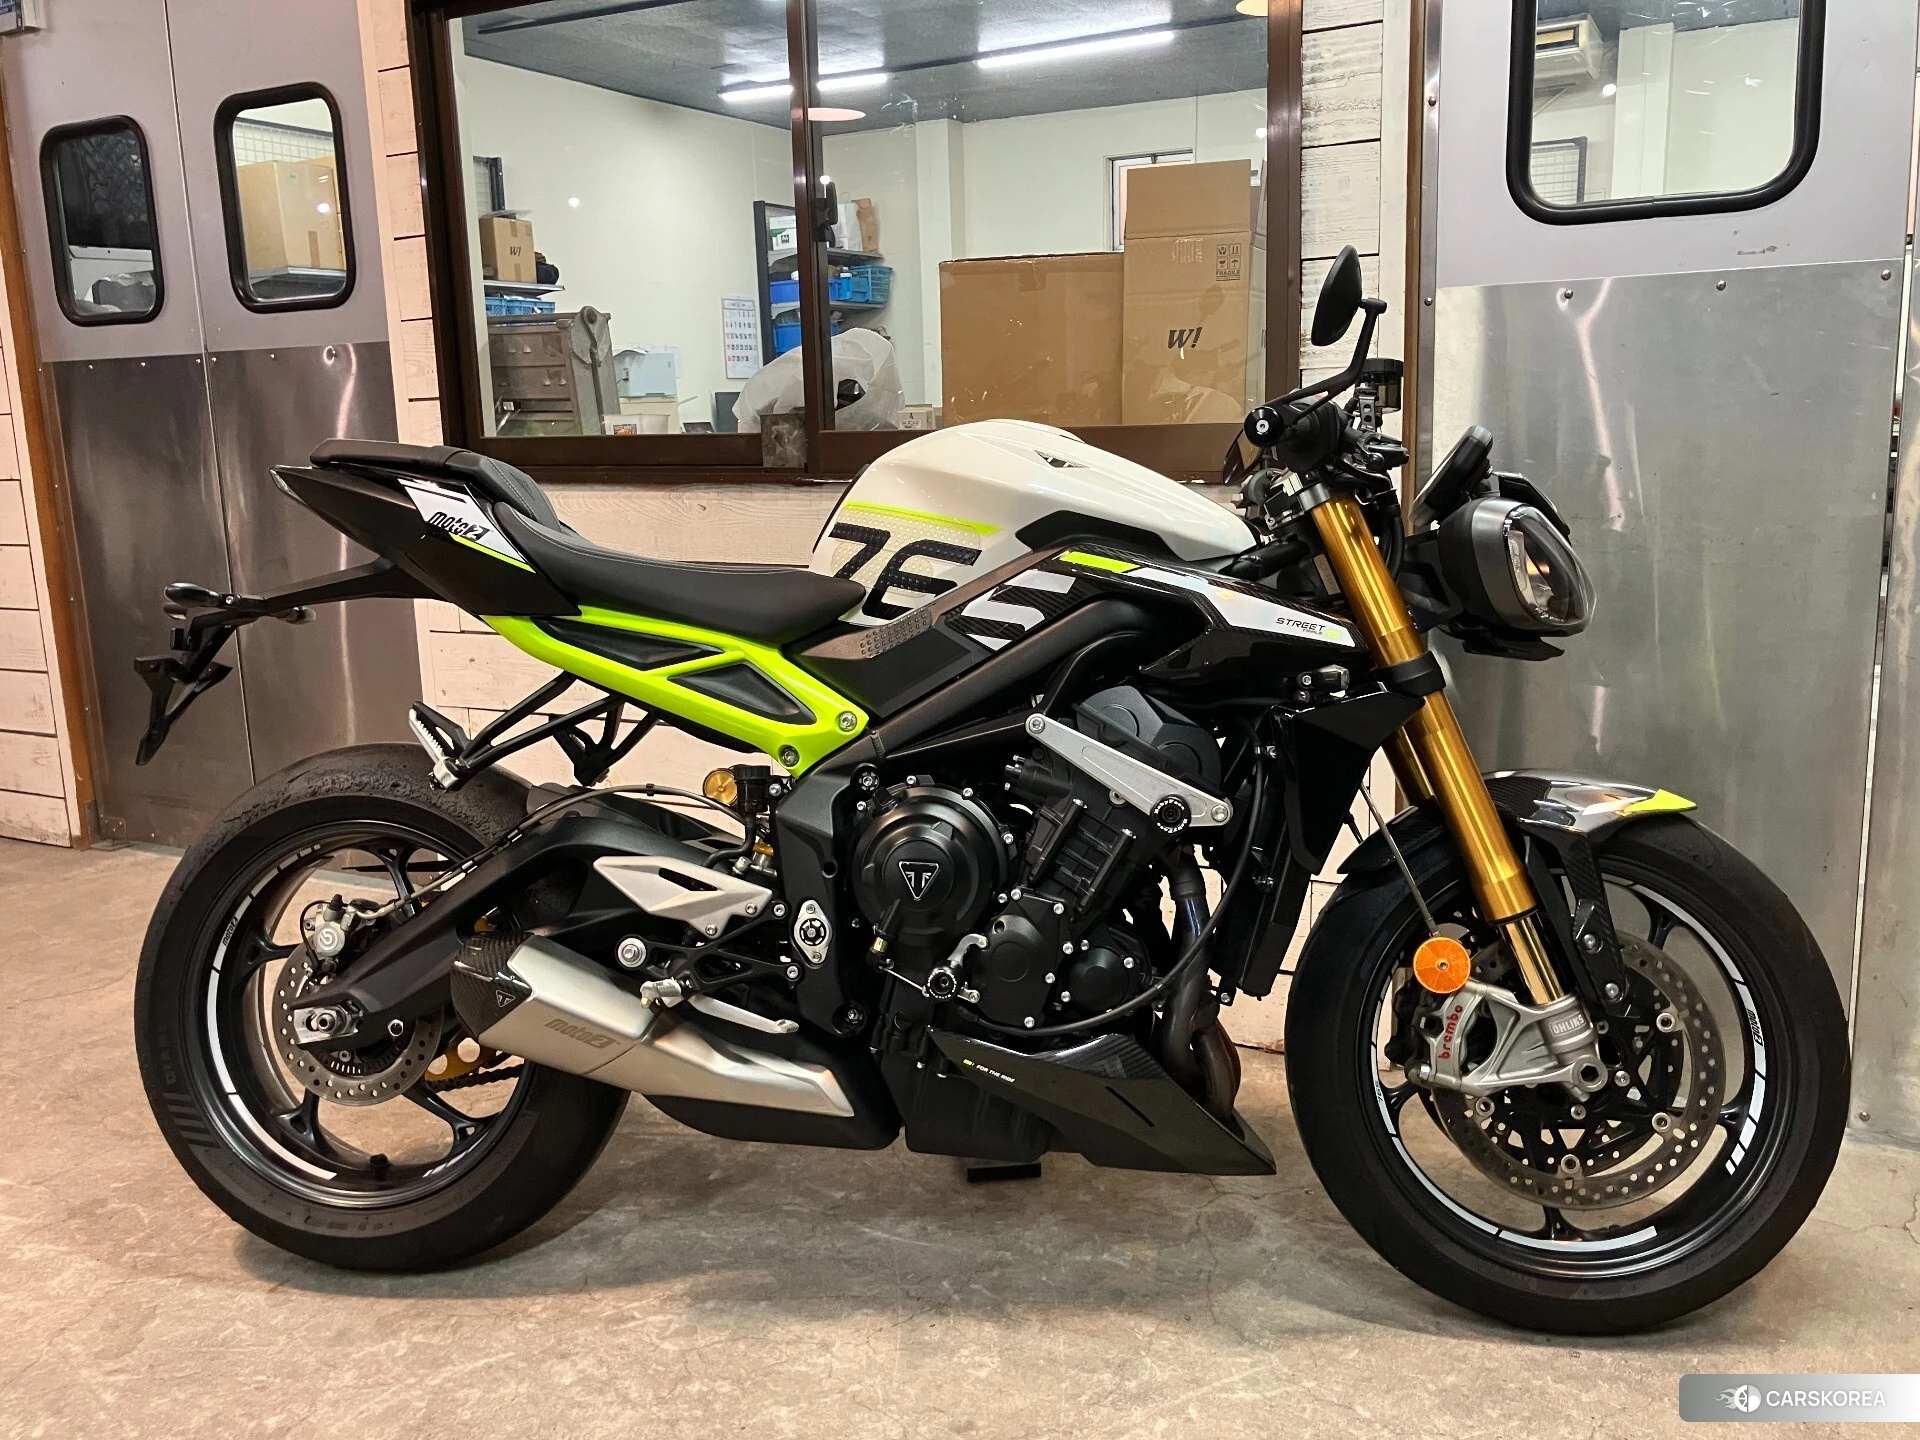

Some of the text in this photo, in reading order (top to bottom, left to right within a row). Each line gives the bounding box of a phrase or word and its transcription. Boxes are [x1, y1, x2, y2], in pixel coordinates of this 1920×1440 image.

[1167, 326, 1203, 349] W!
[1276, 617, 1327, 632] STREET
[1438, 1005, 1463, 1060] brembo
[976, 1064, 989, 1073] FOR
[989, 1069, 1001, 1078] THE
